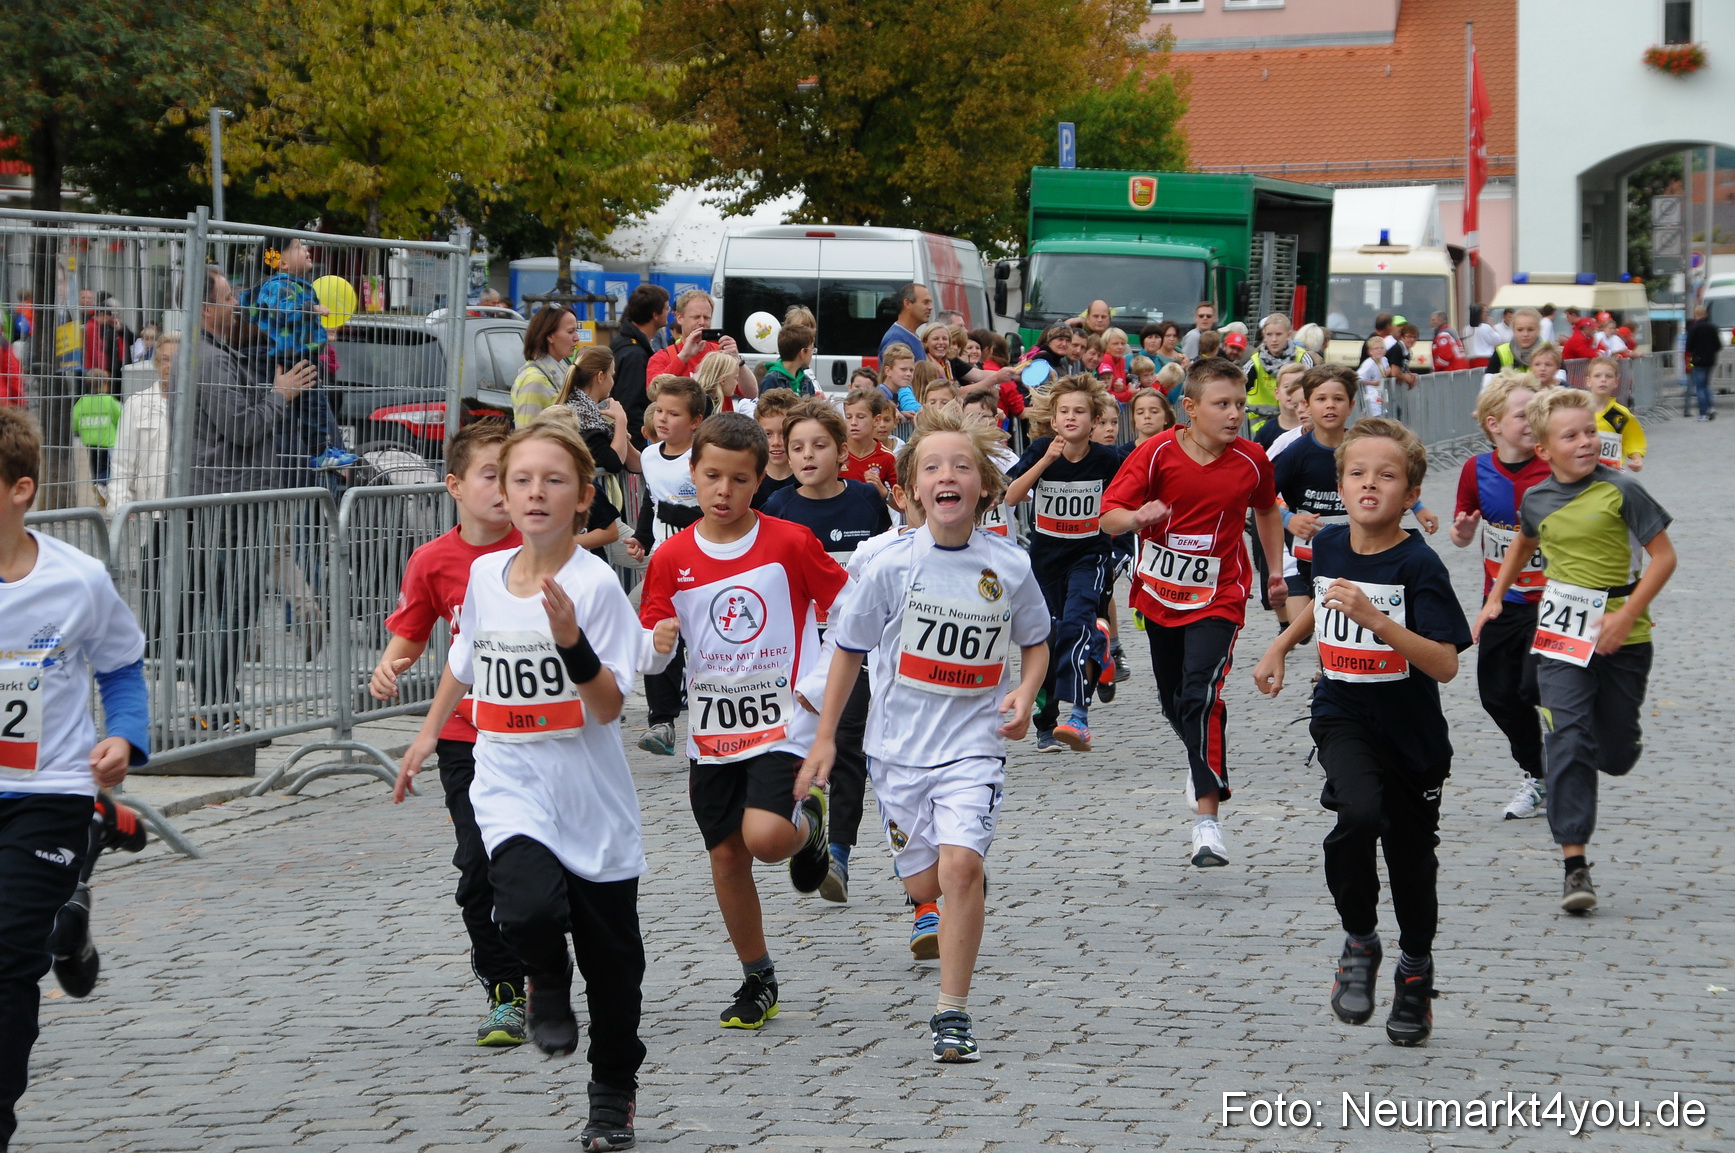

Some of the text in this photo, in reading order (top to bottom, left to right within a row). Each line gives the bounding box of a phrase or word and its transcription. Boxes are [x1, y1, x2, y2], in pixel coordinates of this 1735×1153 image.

[1062, 130, 1071, 162] P
[1060, 486, 1092, 494] Neumarkt
[1042, 495, 1094, 517] 7000
[1056, 522, 1079, 532] Elias
[1149, 545, 1209, 583] 7078
[1154, 582, 1191, 601] Lorenz
[1552, 588, 1590, 604] Neumarkt
[908, 600, 1000, 623] PARTL Neumarkt
[498, 641, 552, 653] Neumarkt
[917, 616, 1002, 660] 7067
[736, 652, 755, 661] MIT
[760, 646, 788, 659] HERZ
[1330, 650, 1376, 670] Lorenz
[718, 665, 735, 673] Heck
[752, 661, 779, 670] Röschl
[928, 665, 976, 684] Justin
[480, 655, 565, 699] 7069
[721, 681, 771, 694] Neumarkt
[506, 711, 535, 729] Jan
[697, 692, 781, 730] 7065
